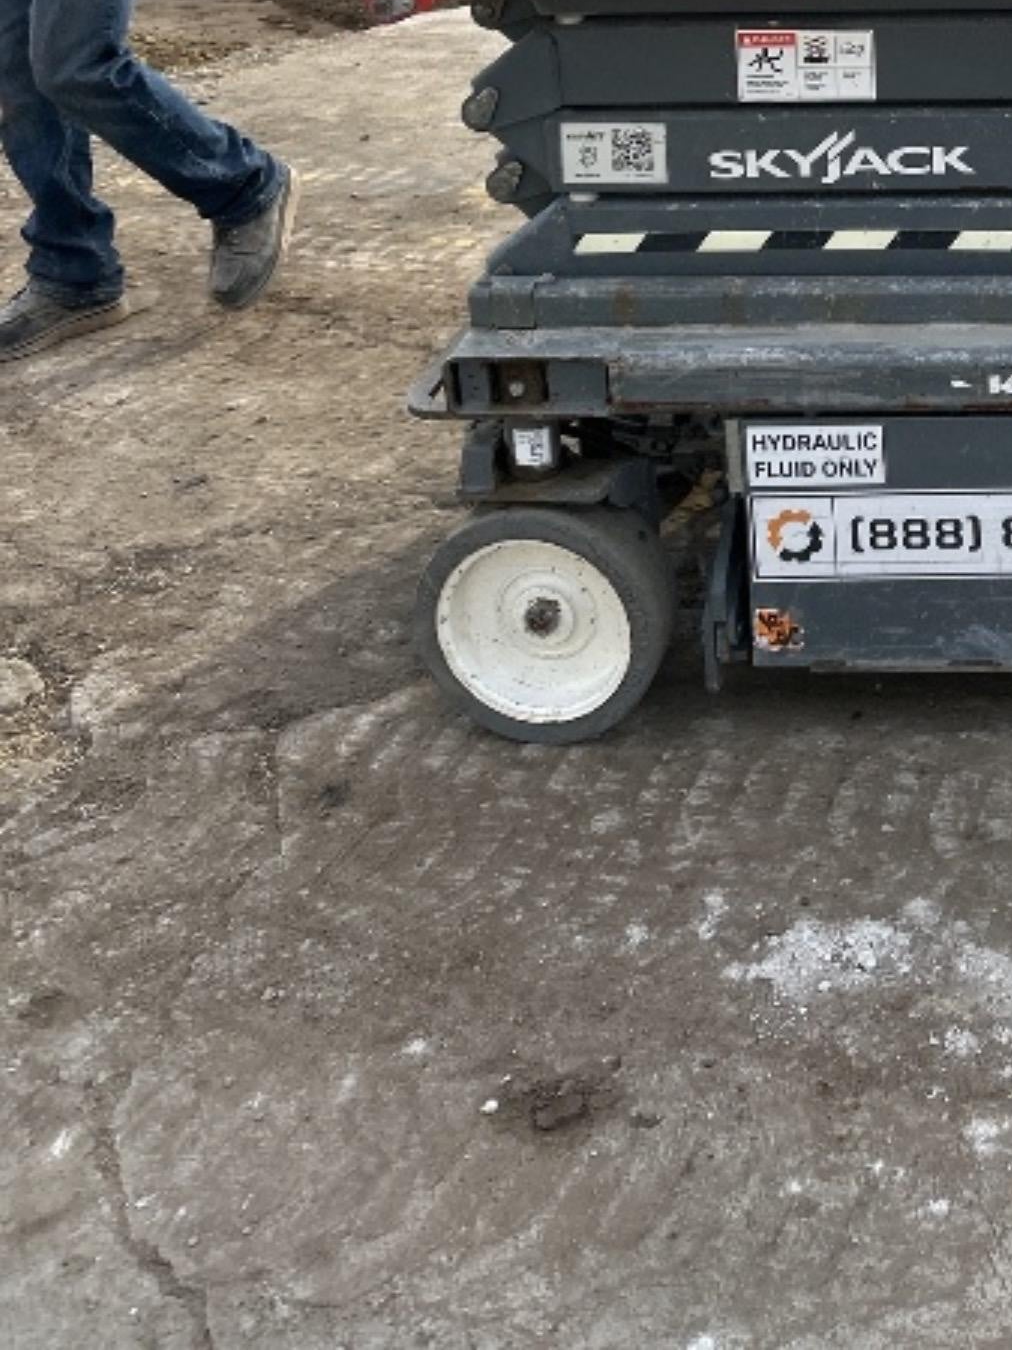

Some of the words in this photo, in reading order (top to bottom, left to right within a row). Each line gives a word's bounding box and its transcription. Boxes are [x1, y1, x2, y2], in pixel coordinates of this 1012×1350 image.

[708, 130, 976, 184] SKYJACK
[751, 431, 878, 453] HYDRAULIC
[754, 460, 817, 479] FLUID
[821, 457, 878, 478] ONLY
[850, 515, 982, 553] (888)
